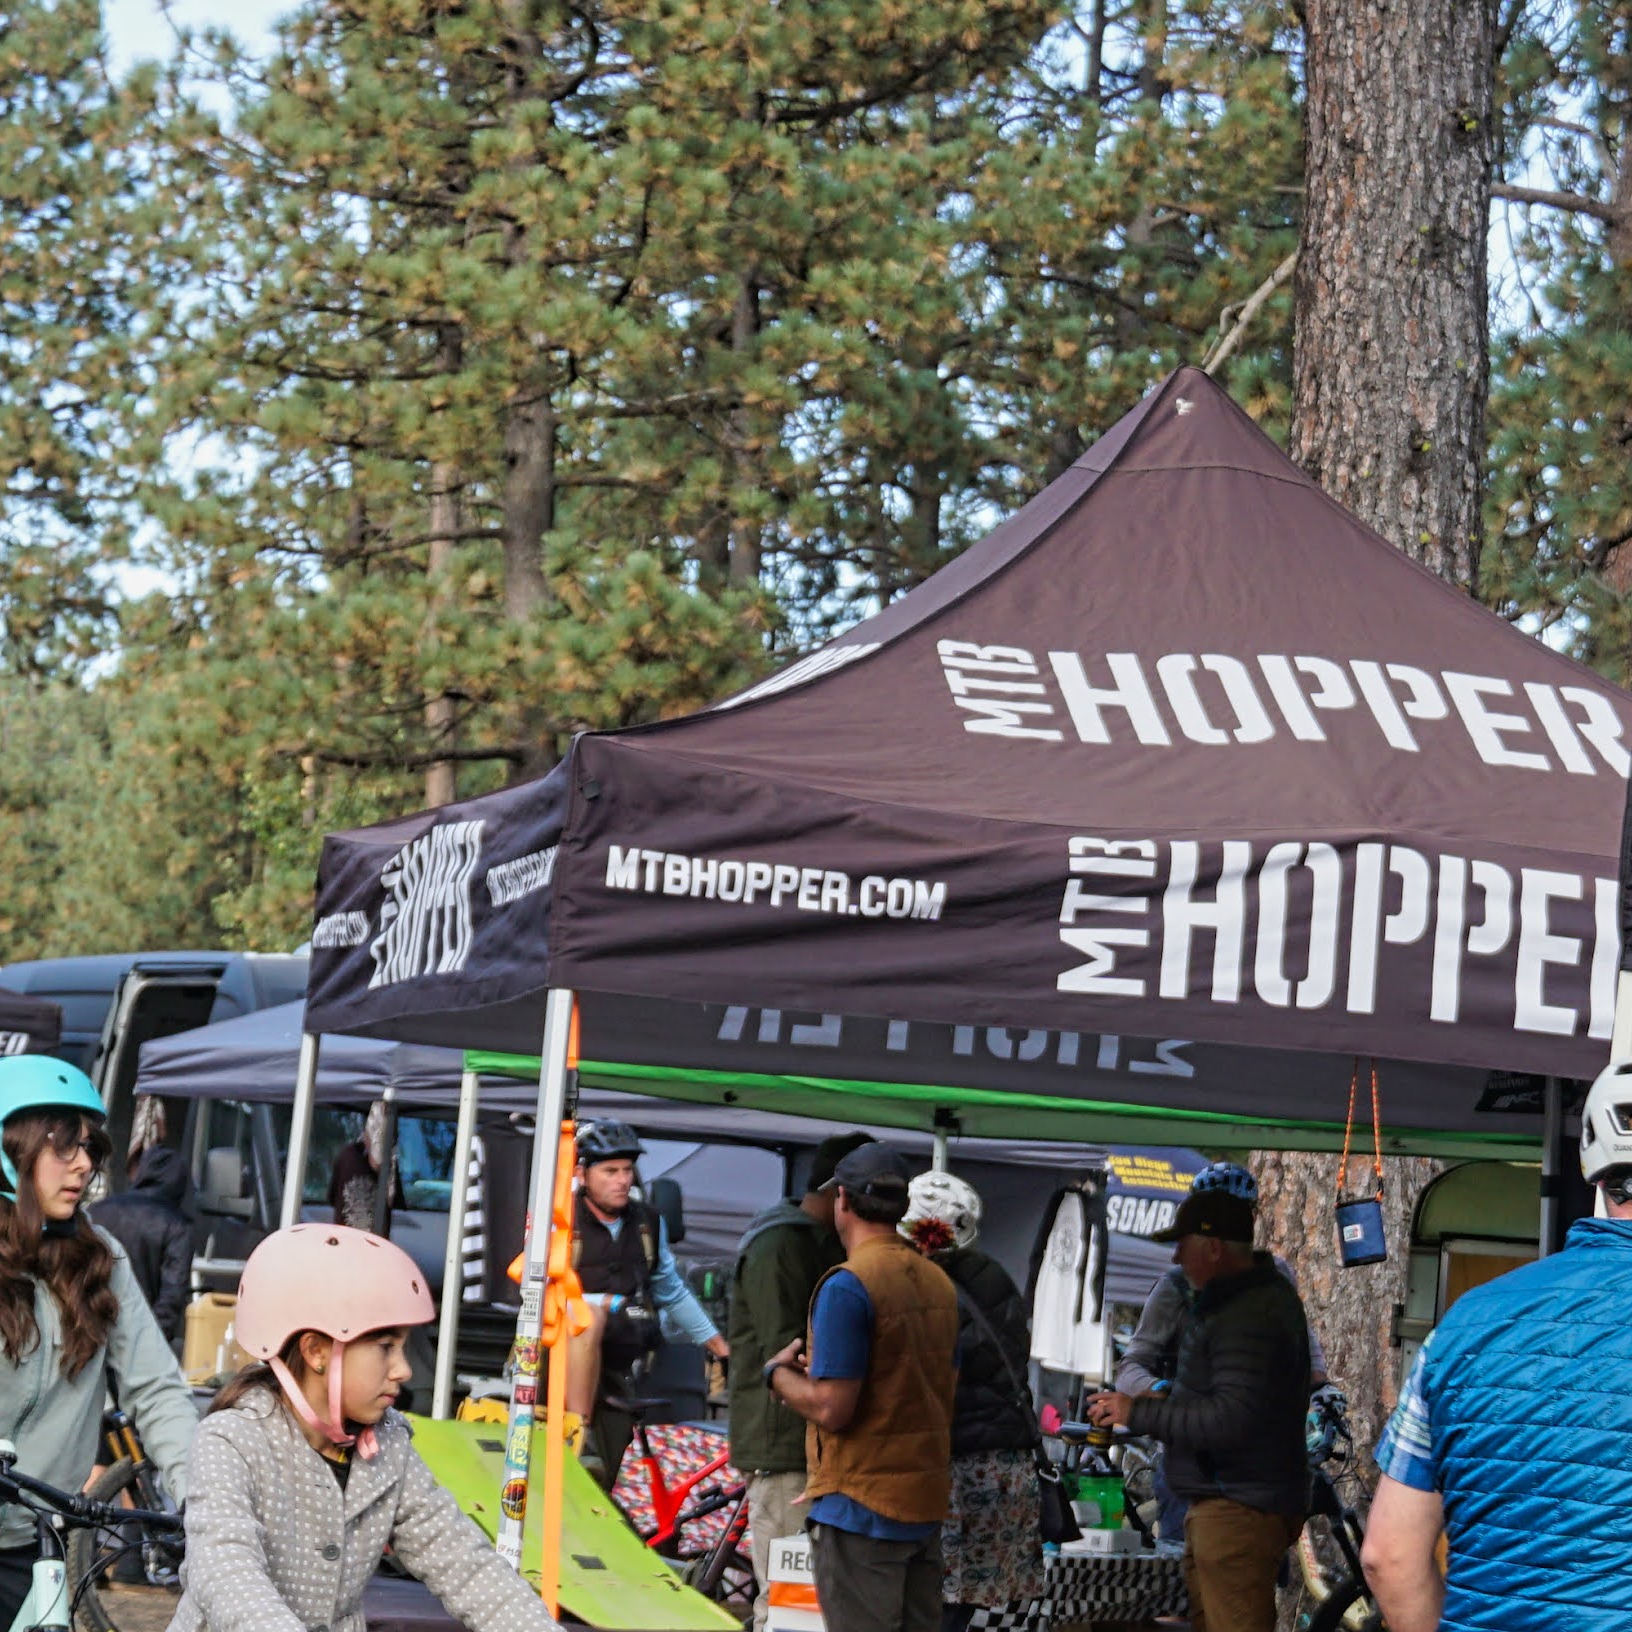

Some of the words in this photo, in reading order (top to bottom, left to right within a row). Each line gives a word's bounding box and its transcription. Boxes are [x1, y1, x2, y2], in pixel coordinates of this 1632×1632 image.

[936, 638, 1064, 743] MTB
[1047, 650, 1631, 778] HOPPER
[605, 843, 947, 920] MTBHOPPER.COM
[1057, 836, 1157, 996] MTB
